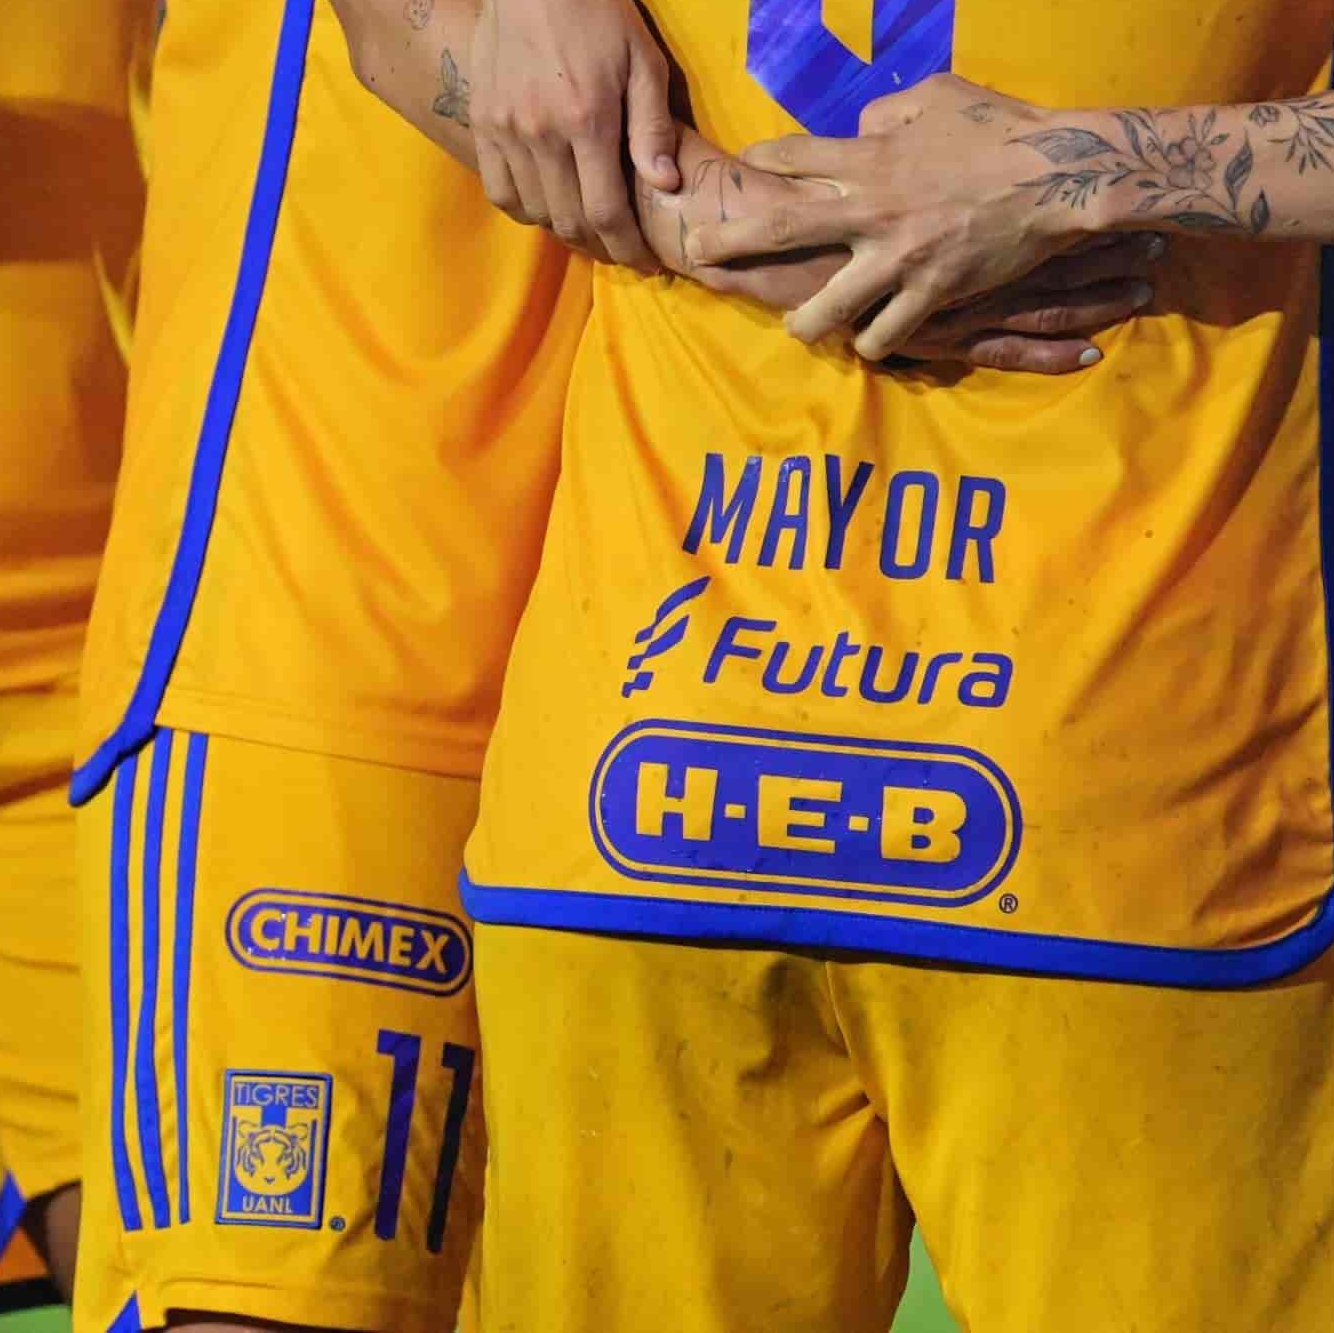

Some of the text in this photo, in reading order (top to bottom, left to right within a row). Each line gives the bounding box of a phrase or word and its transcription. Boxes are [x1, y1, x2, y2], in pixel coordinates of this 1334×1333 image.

[681, 452, 1007, 584] MAYOR
[702, 616, 1014, 708] Futura
[635, 761, 968, 864] H-E-B
[250, 908, 449, 974] CHIMEX
[235, 1082, 319, 1108] TIGRES
[375, 1029, 475, 1254] 11
[242, 1195, 294, 1213] UANL
